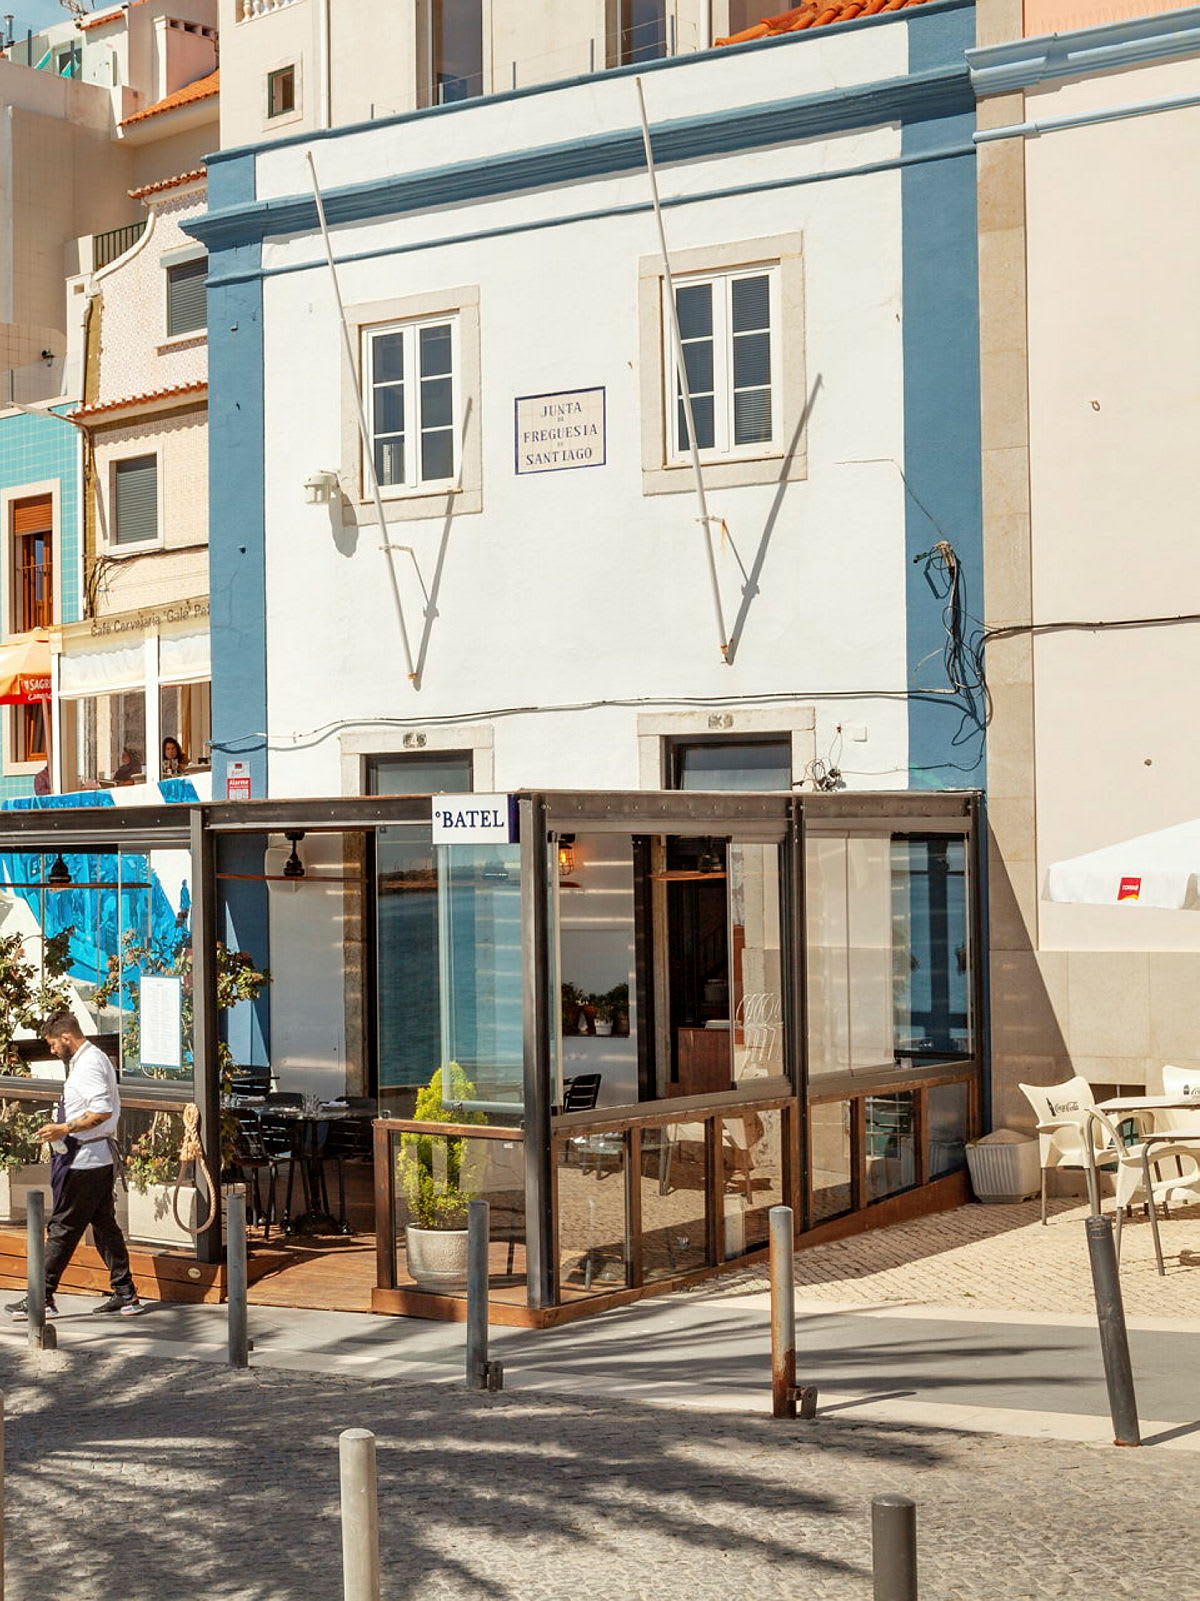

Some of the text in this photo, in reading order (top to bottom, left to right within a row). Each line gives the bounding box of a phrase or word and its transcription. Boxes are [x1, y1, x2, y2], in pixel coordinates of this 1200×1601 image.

[541, 402, 582, 417] JUNTA
[521, 424, 598, 443] FREGUESIA
[526, 447, 593, 465] SANTIAGO
